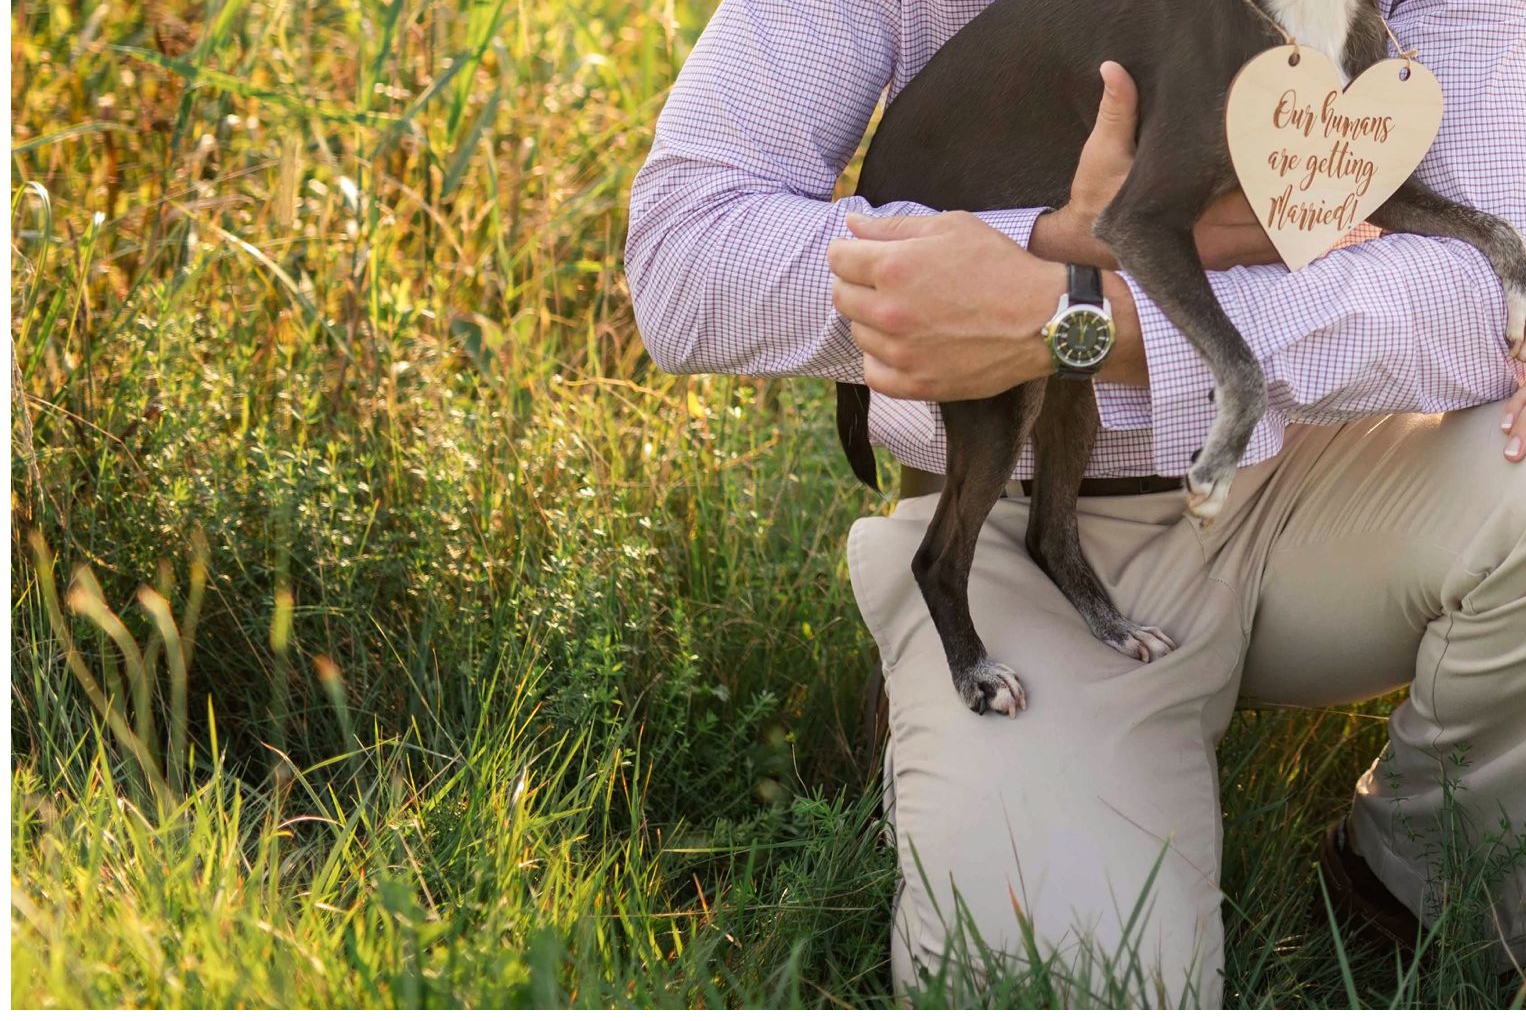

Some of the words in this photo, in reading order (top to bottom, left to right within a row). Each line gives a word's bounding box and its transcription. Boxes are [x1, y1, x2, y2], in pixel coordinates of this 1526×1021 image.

[1273, 89, 1317, 137] Our
[1321, 90, 1395, 143] humans
[1268, 148, 1300, 177] are
[1300, 141, 1378, 197] getting
[1268, 184, 1358, 231] Married!
